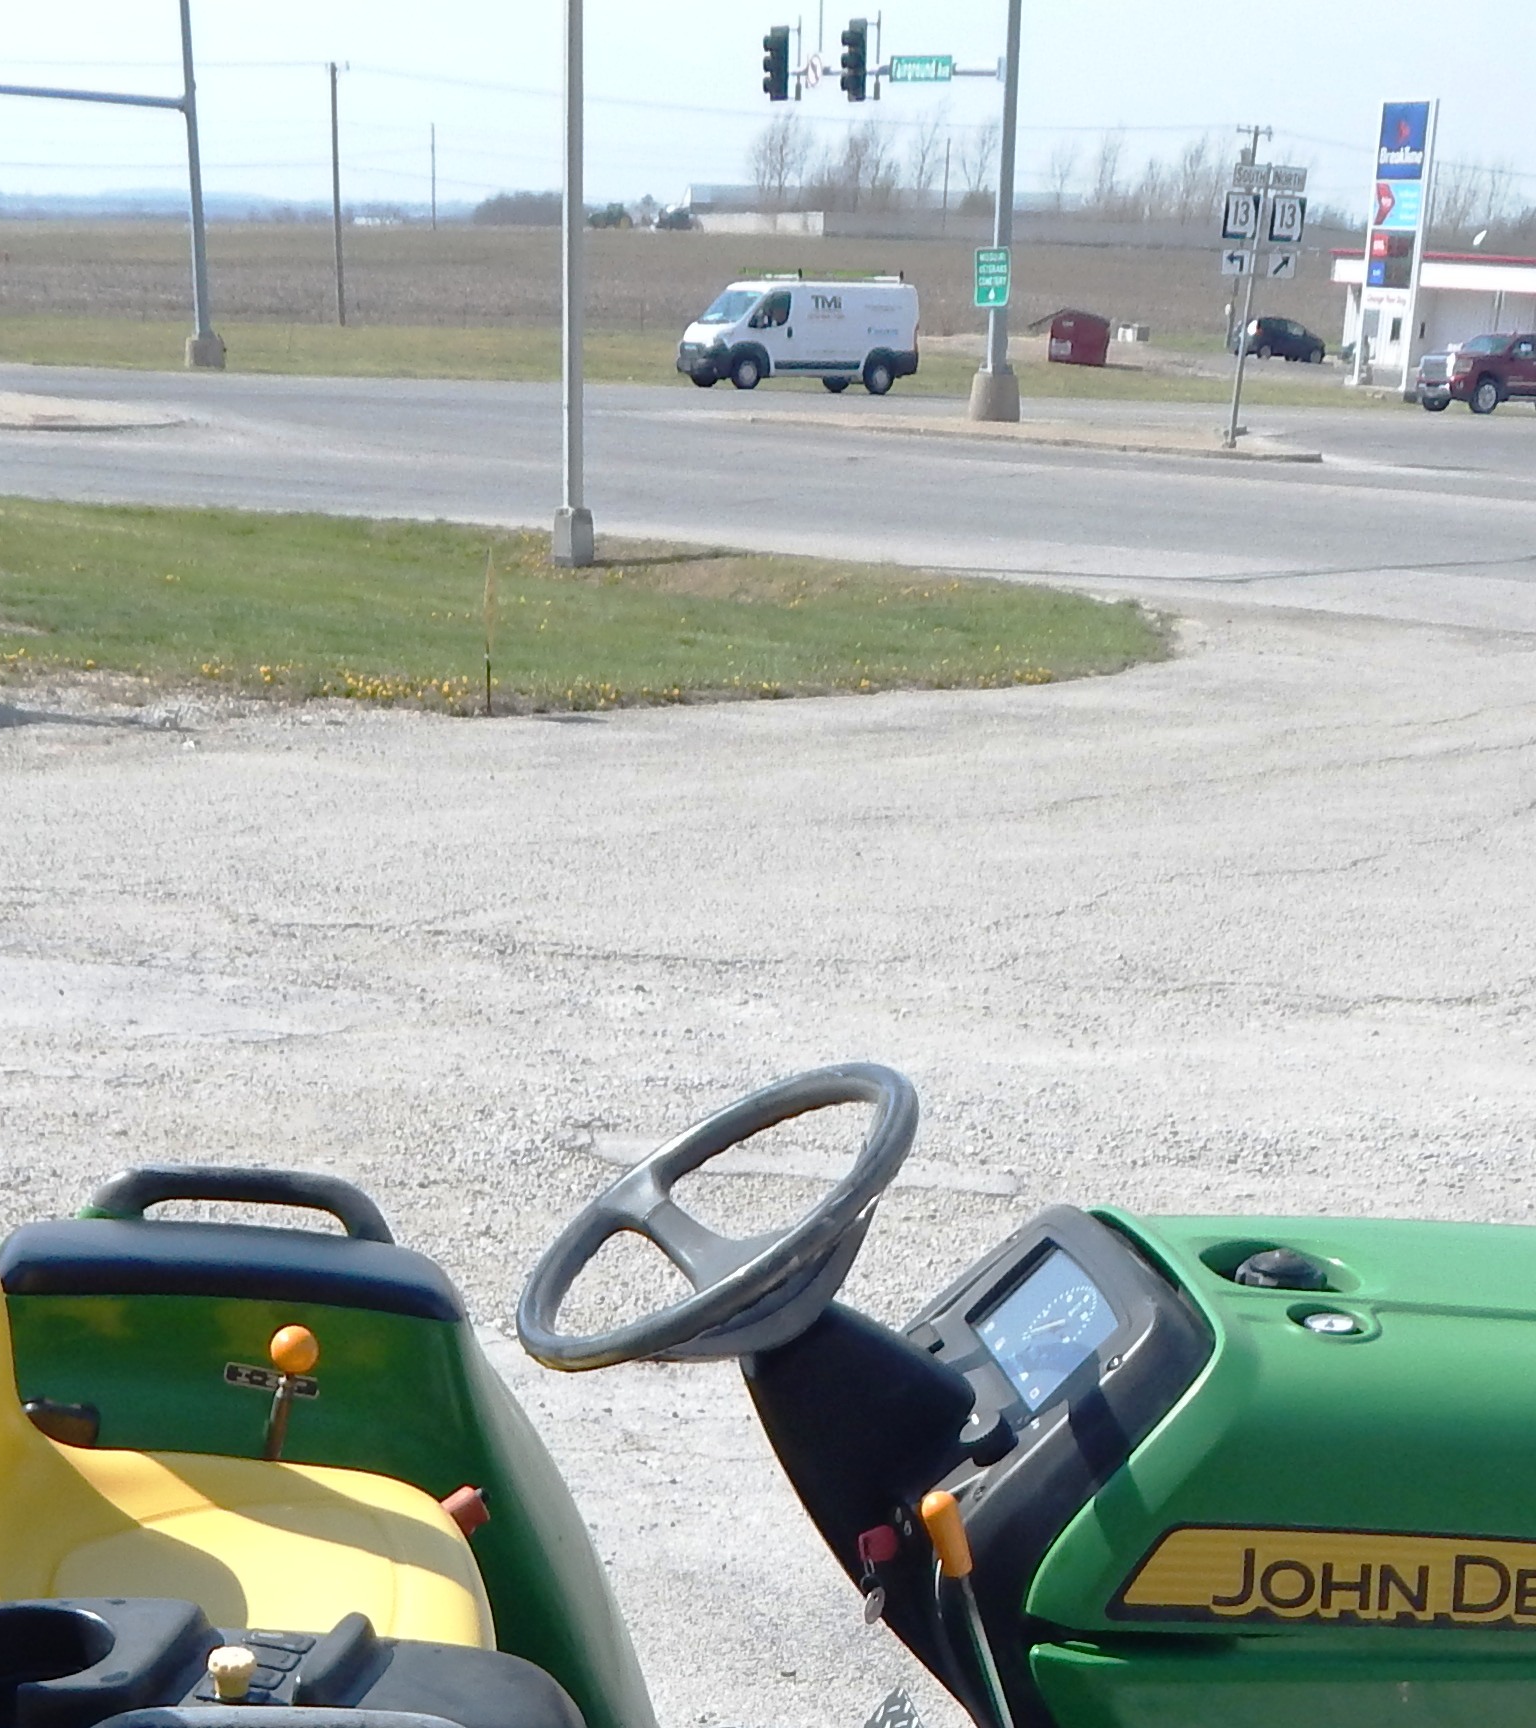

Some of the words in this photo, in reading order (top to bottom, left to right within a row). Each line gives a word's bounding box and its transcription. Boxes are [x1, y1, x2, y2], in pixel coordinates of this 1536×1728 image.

[892, 57, 936, 81] Fairground
[1233, 200, 1251, 227] 13
[1279, 203, 1297, 230] 13
[1212, 1548, 1430, 1613] JOHN
